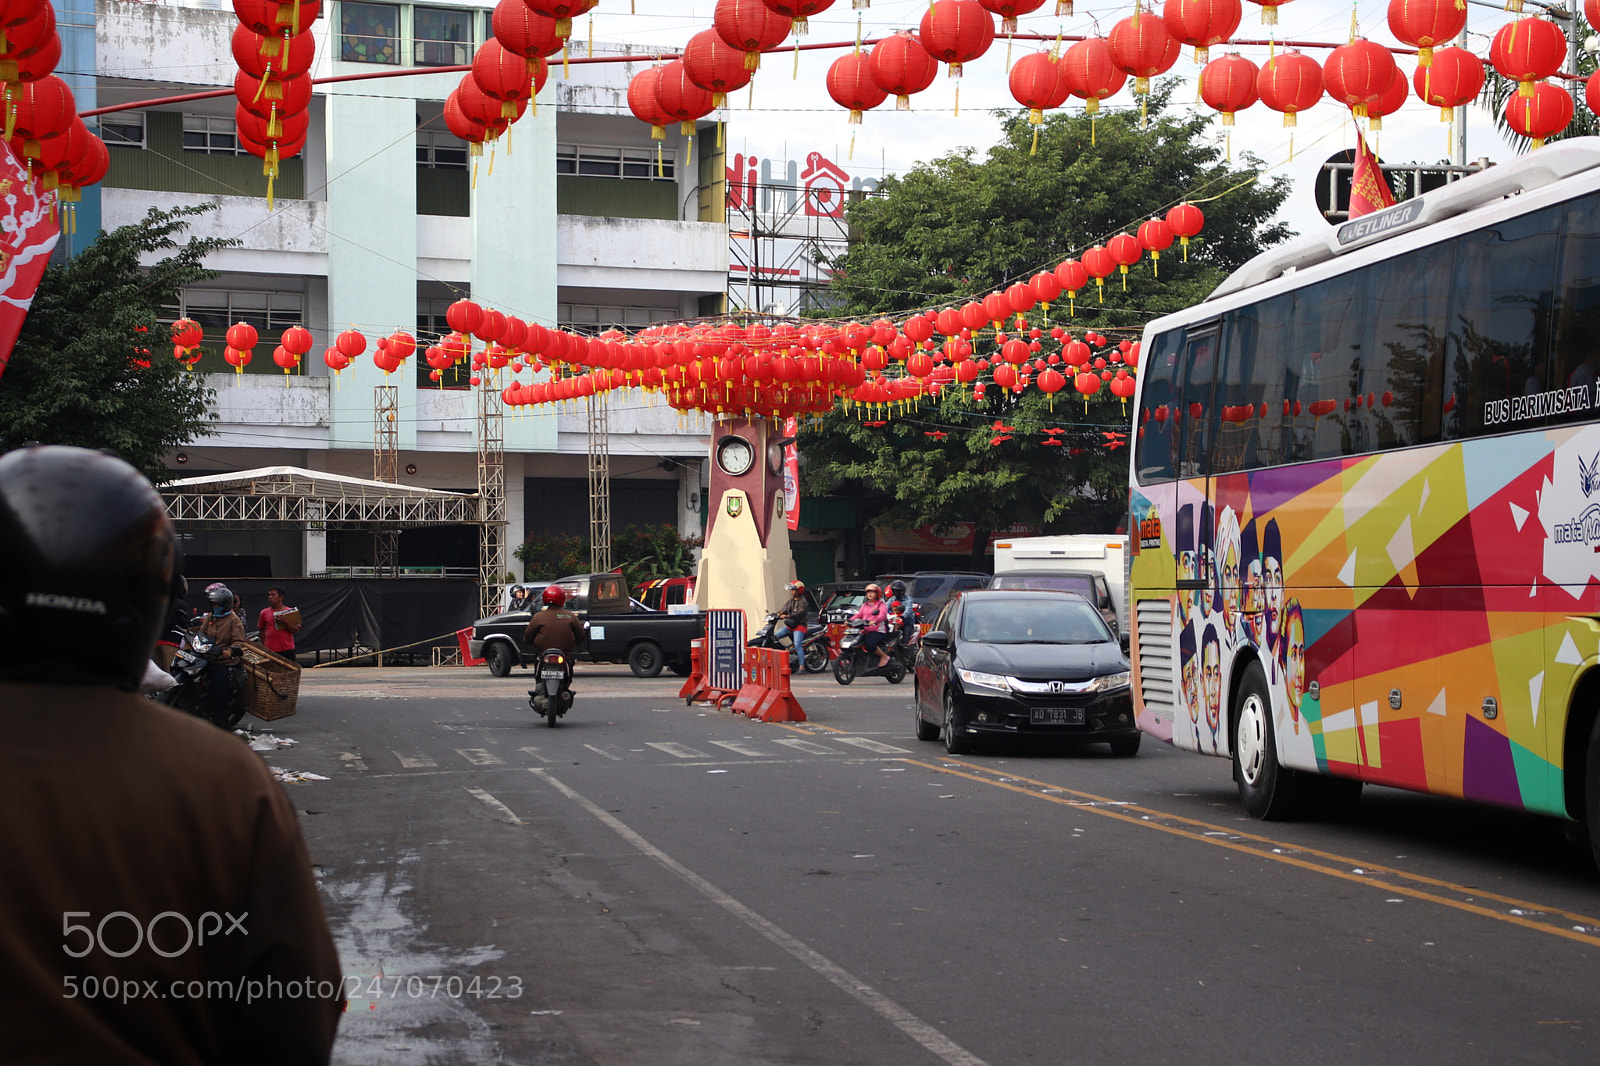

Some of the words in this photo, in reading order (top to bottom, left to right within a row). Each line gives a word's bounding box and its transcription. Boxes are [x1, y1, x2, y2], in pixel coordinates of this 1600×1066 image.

[1347, 206, 1413, 237] JETLINER
[1484, 398, 1510, 425] BUS
[1511, 384, 1591, 421] PARIWISATA
[1140, 511, 1161, 539] mata
[26, 592, 107, 615] HONDA
[1034, 709, 1044, 719] AD
[1048, 709, 1067, 719] 7831
